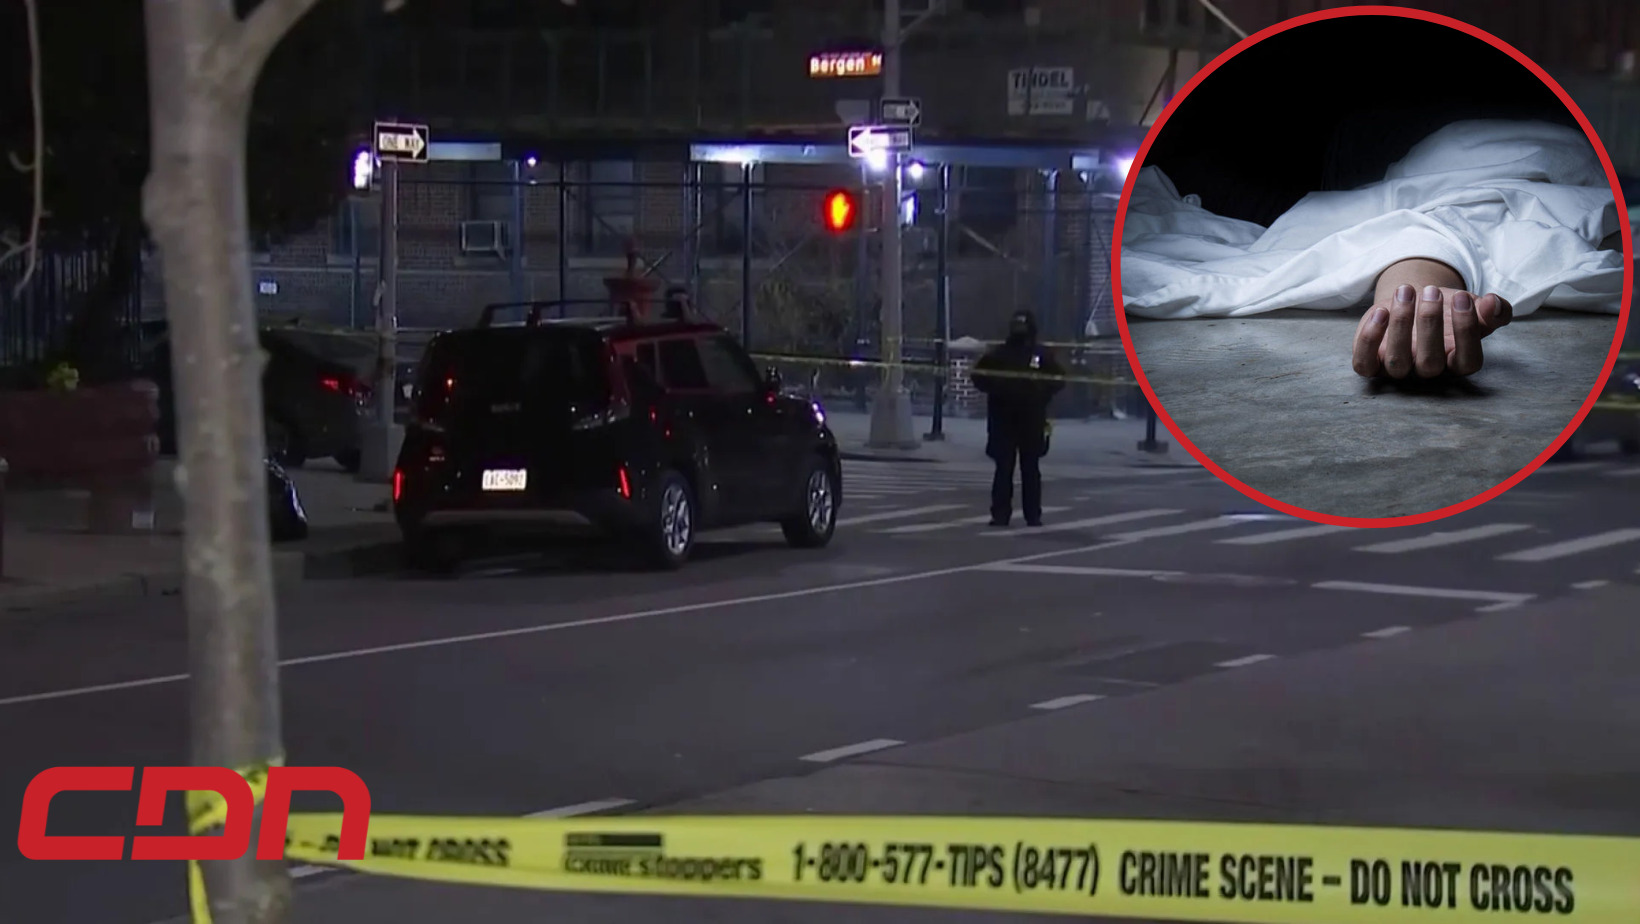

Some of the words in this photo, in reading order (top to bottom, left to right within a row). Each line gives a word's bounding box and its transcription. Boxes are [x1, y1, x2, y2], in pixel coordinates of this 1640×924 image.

[810, 56, 865, 76] Bergen
[791, 842, 1005, 889] 1-800-577-TIPS
[1013, 841, 1099, 896] (8477)
[1120, 850, 1210, 898] CRIME
[1219, 854, 1314, 902] SCENE
[1350, 859, 1392, 906] DO
[1401, 861, 1461, 908] NOT
[1470, 864, 1575, 914] CROSS
